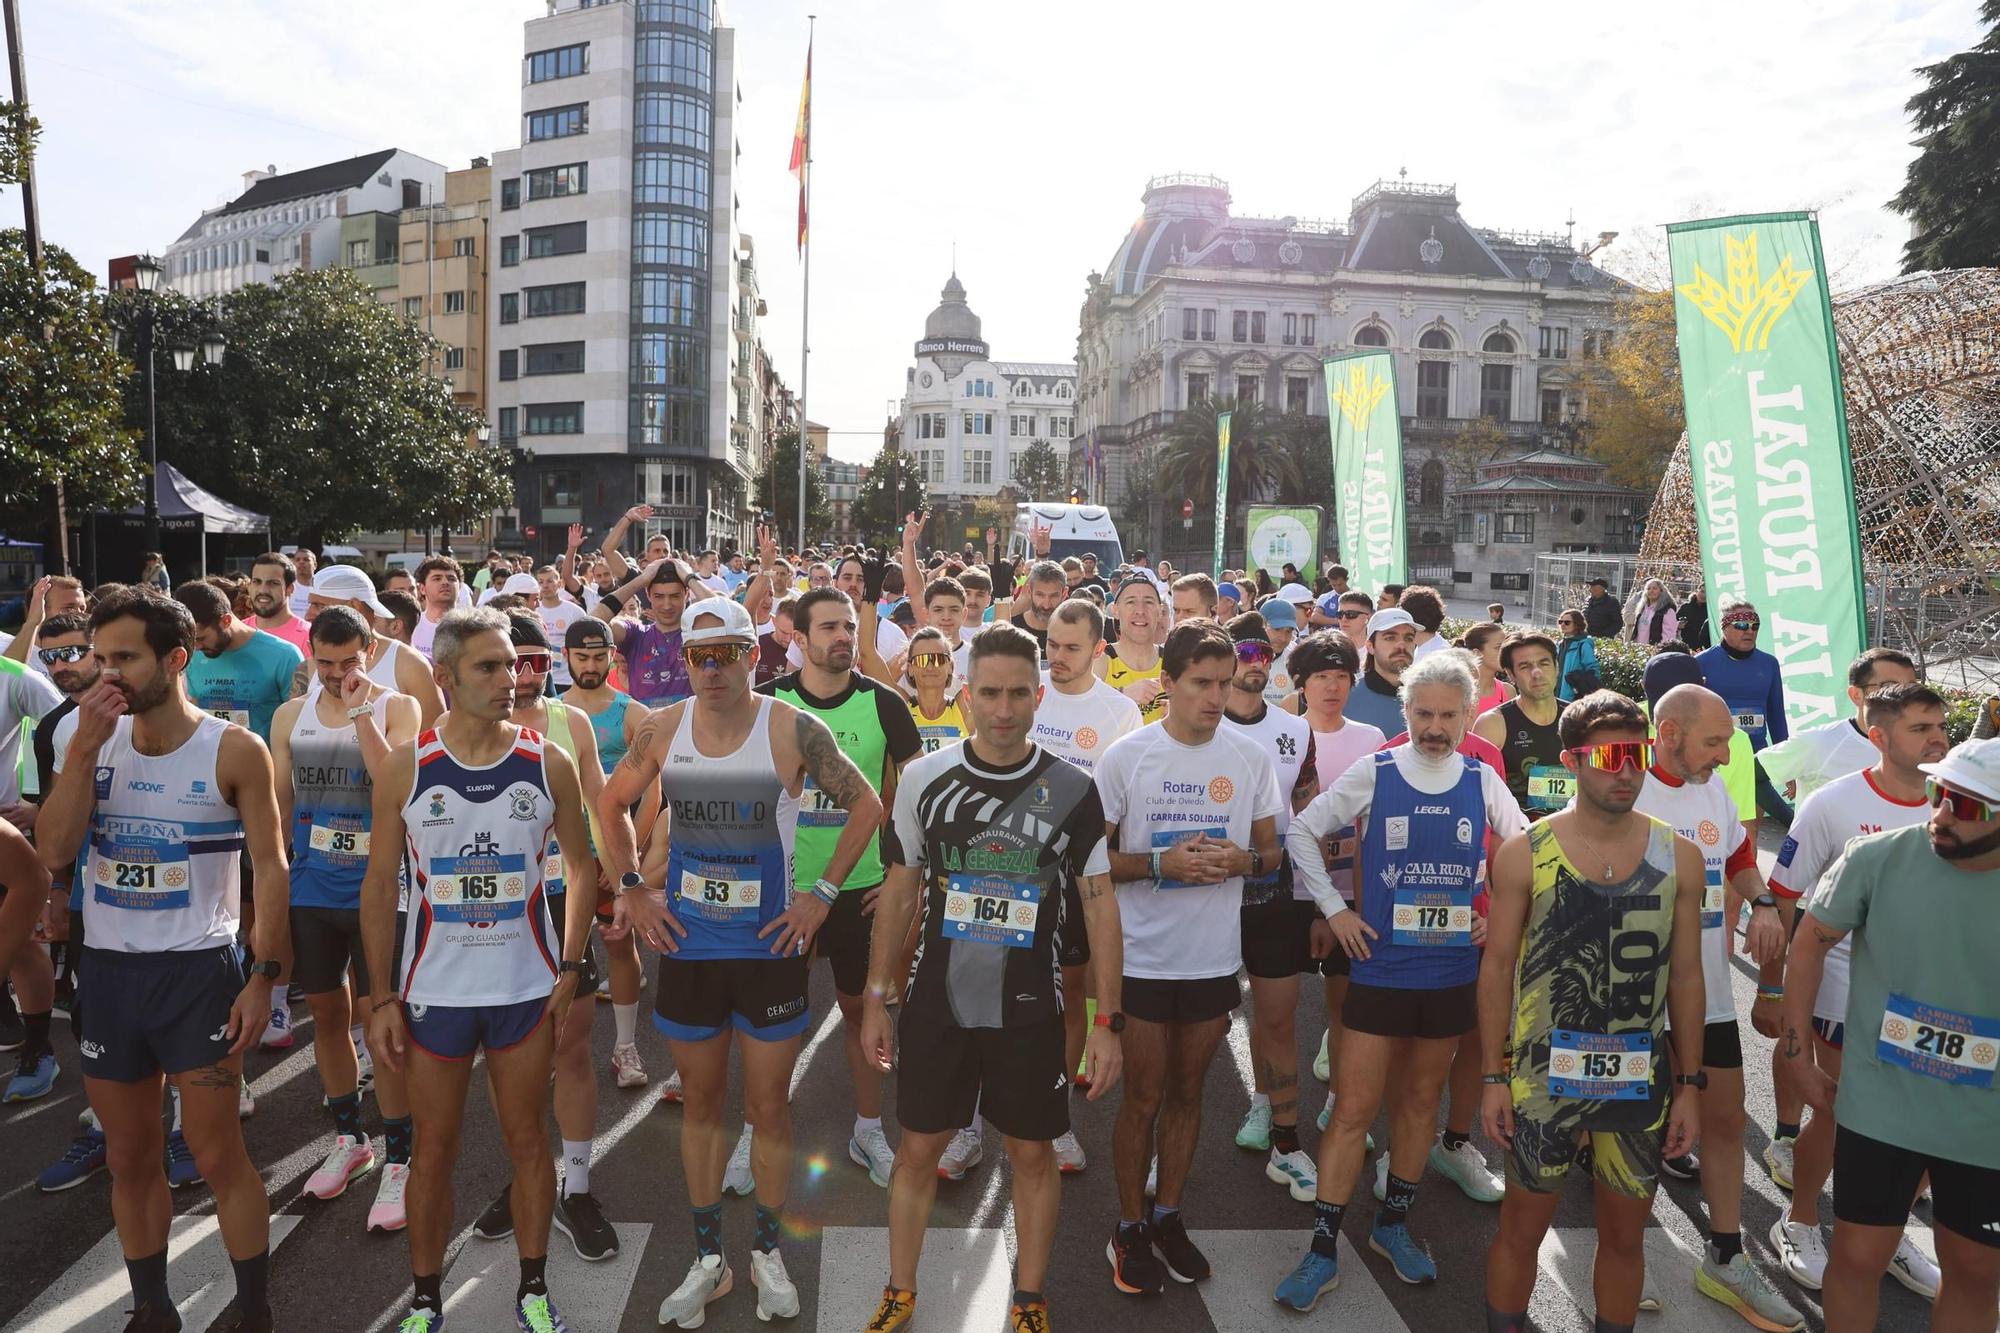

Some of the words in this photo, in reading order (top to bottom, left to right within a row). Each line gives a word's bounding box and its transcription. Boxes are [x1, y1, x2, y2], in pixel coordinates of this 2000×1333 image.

[919, 343, 944, 352] Banco
[948, 342, 984, 354] Herrero
[1738, 716, 1754, 726] 188
[1036, 724, 1072, 740] Rotary
[1163, 781, 1206, 796] Rotary
[1548, 779, 1566, 794] 112
[1146, 797, 1164, 805] Club
[1166, 797, 1176, 805] de
[1178, 797, 1205, 806] Oviedo
[1414, 806, 1450, 815] LEGEA
[1151, 814, 1187, 822] CARRERA
[1189, 814, 1230, 824] SOLIDARIA
[107, 820, 180, 839] PILOÑA
[332, 832, 356, 851] 35
[967, 830, 1027, 849] RESTAURANTE
[112, 844, 158, 856] CARRERA
[940, 841, 962, 872] LA
[965, 848, 1040, 875] CEREZAL
[116, 863, 155, 888] 231
[454, 866, 502, 874] SOLIDARIA
[699, 864, 736, 874] CARRERA
[1405, 863, 1436, 874] CAJA
[1439, 863, 1472, 878] RURA
[460, 876, 498, 899] 165
[973, 880, 1015, 891] CARRERA
[1404, 876, 1417, 884] DE
[1419, 876, 1464, 885] ASTURIAS
[704, 880, 729, 902] 53
[969, 886, 1016, 899] SOLIDARIA
[473, 903, 510, 911] ROTARY
[973, 897, 1009, 923] 164
[460, 911, 496, 920] OVIEDO
[1418, 908, 1448, 928] 178
[446, 934, 475, 943] GRUPO
[1611, 895, 1660, 1034] LOB
[767, 996, 804, 1017] CEACTIVO
[1576, 1042, 1628, 1051] SOLIDARIA
[1580, 1035, 1626, 1044] CARRERA
[1915, 1025, 1965, 1058] 218
[1582, 1054, 1621, 1077] 153
[1580, 1088, 1617, 1096] OVIEDO
